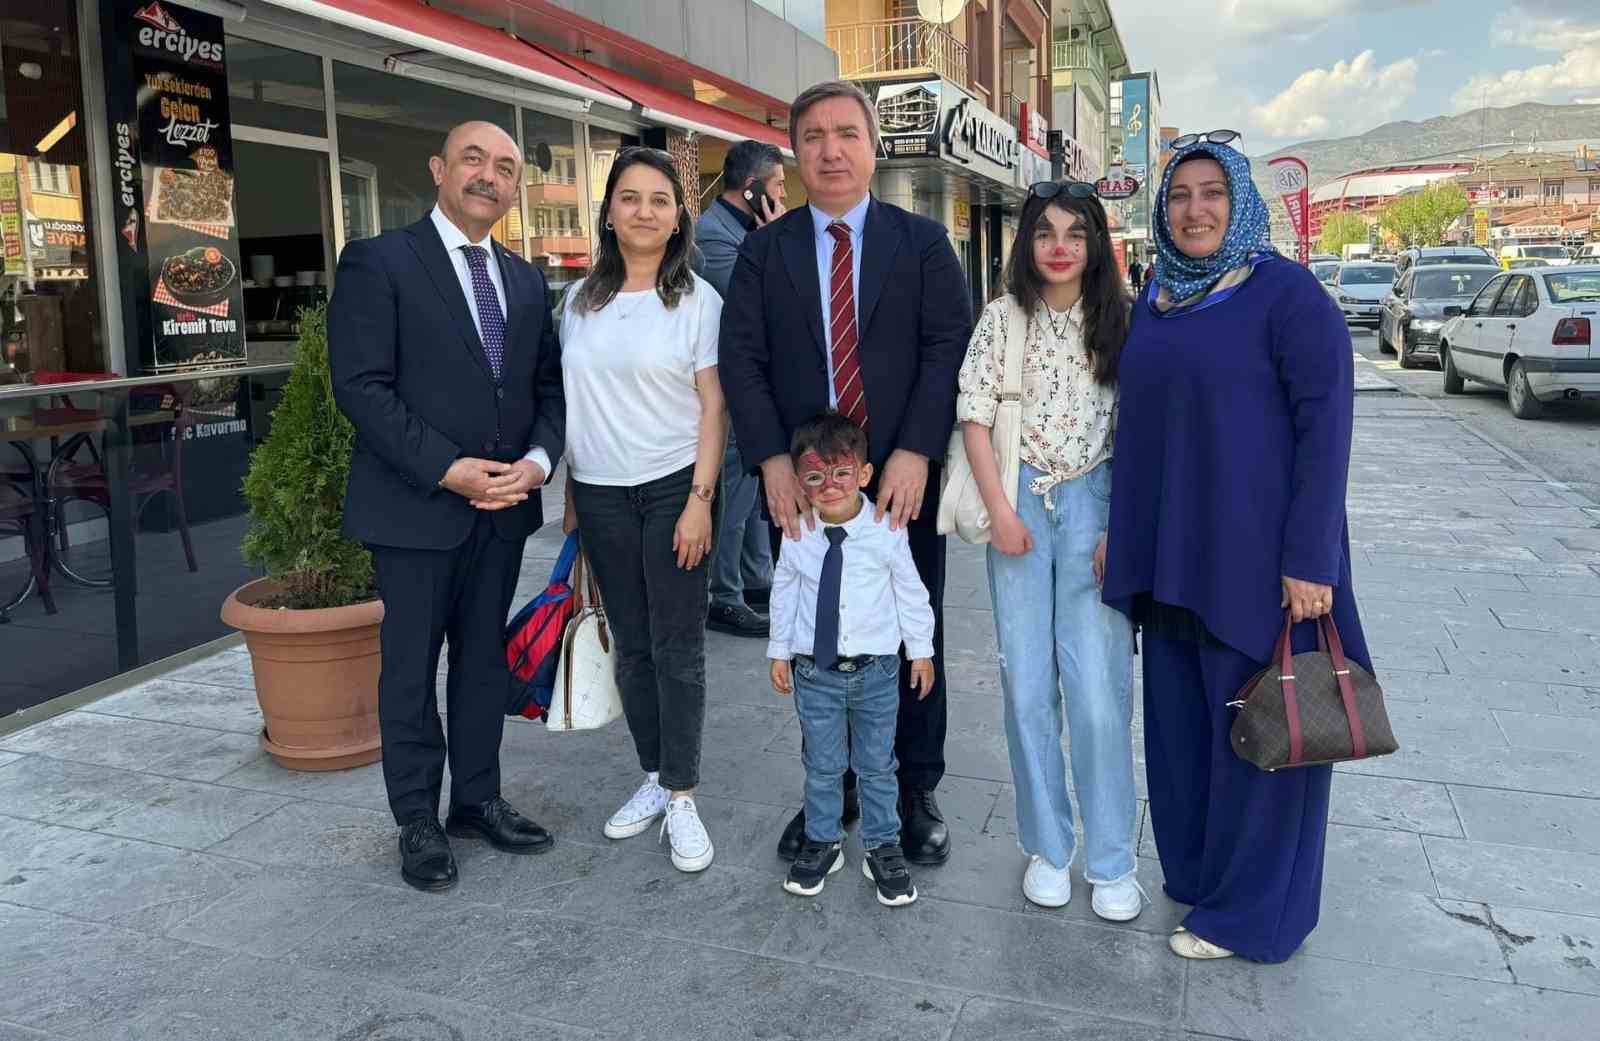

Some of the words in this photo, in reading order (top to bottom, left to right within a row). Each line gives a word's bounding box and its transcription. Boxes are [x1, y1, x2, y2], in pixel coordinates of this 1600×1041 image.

[139, 27, 223, 62] erciyes
[158, 117, 219, 147] Lezzet
[115, 122, 136, 206] erciyes
[1099, 179, 1132, 193] HAS
[163, 318, 207, 336] Kiremit
[209, 318, 237, 334] Tava
[196, 418, 247, 438] Kavurma
